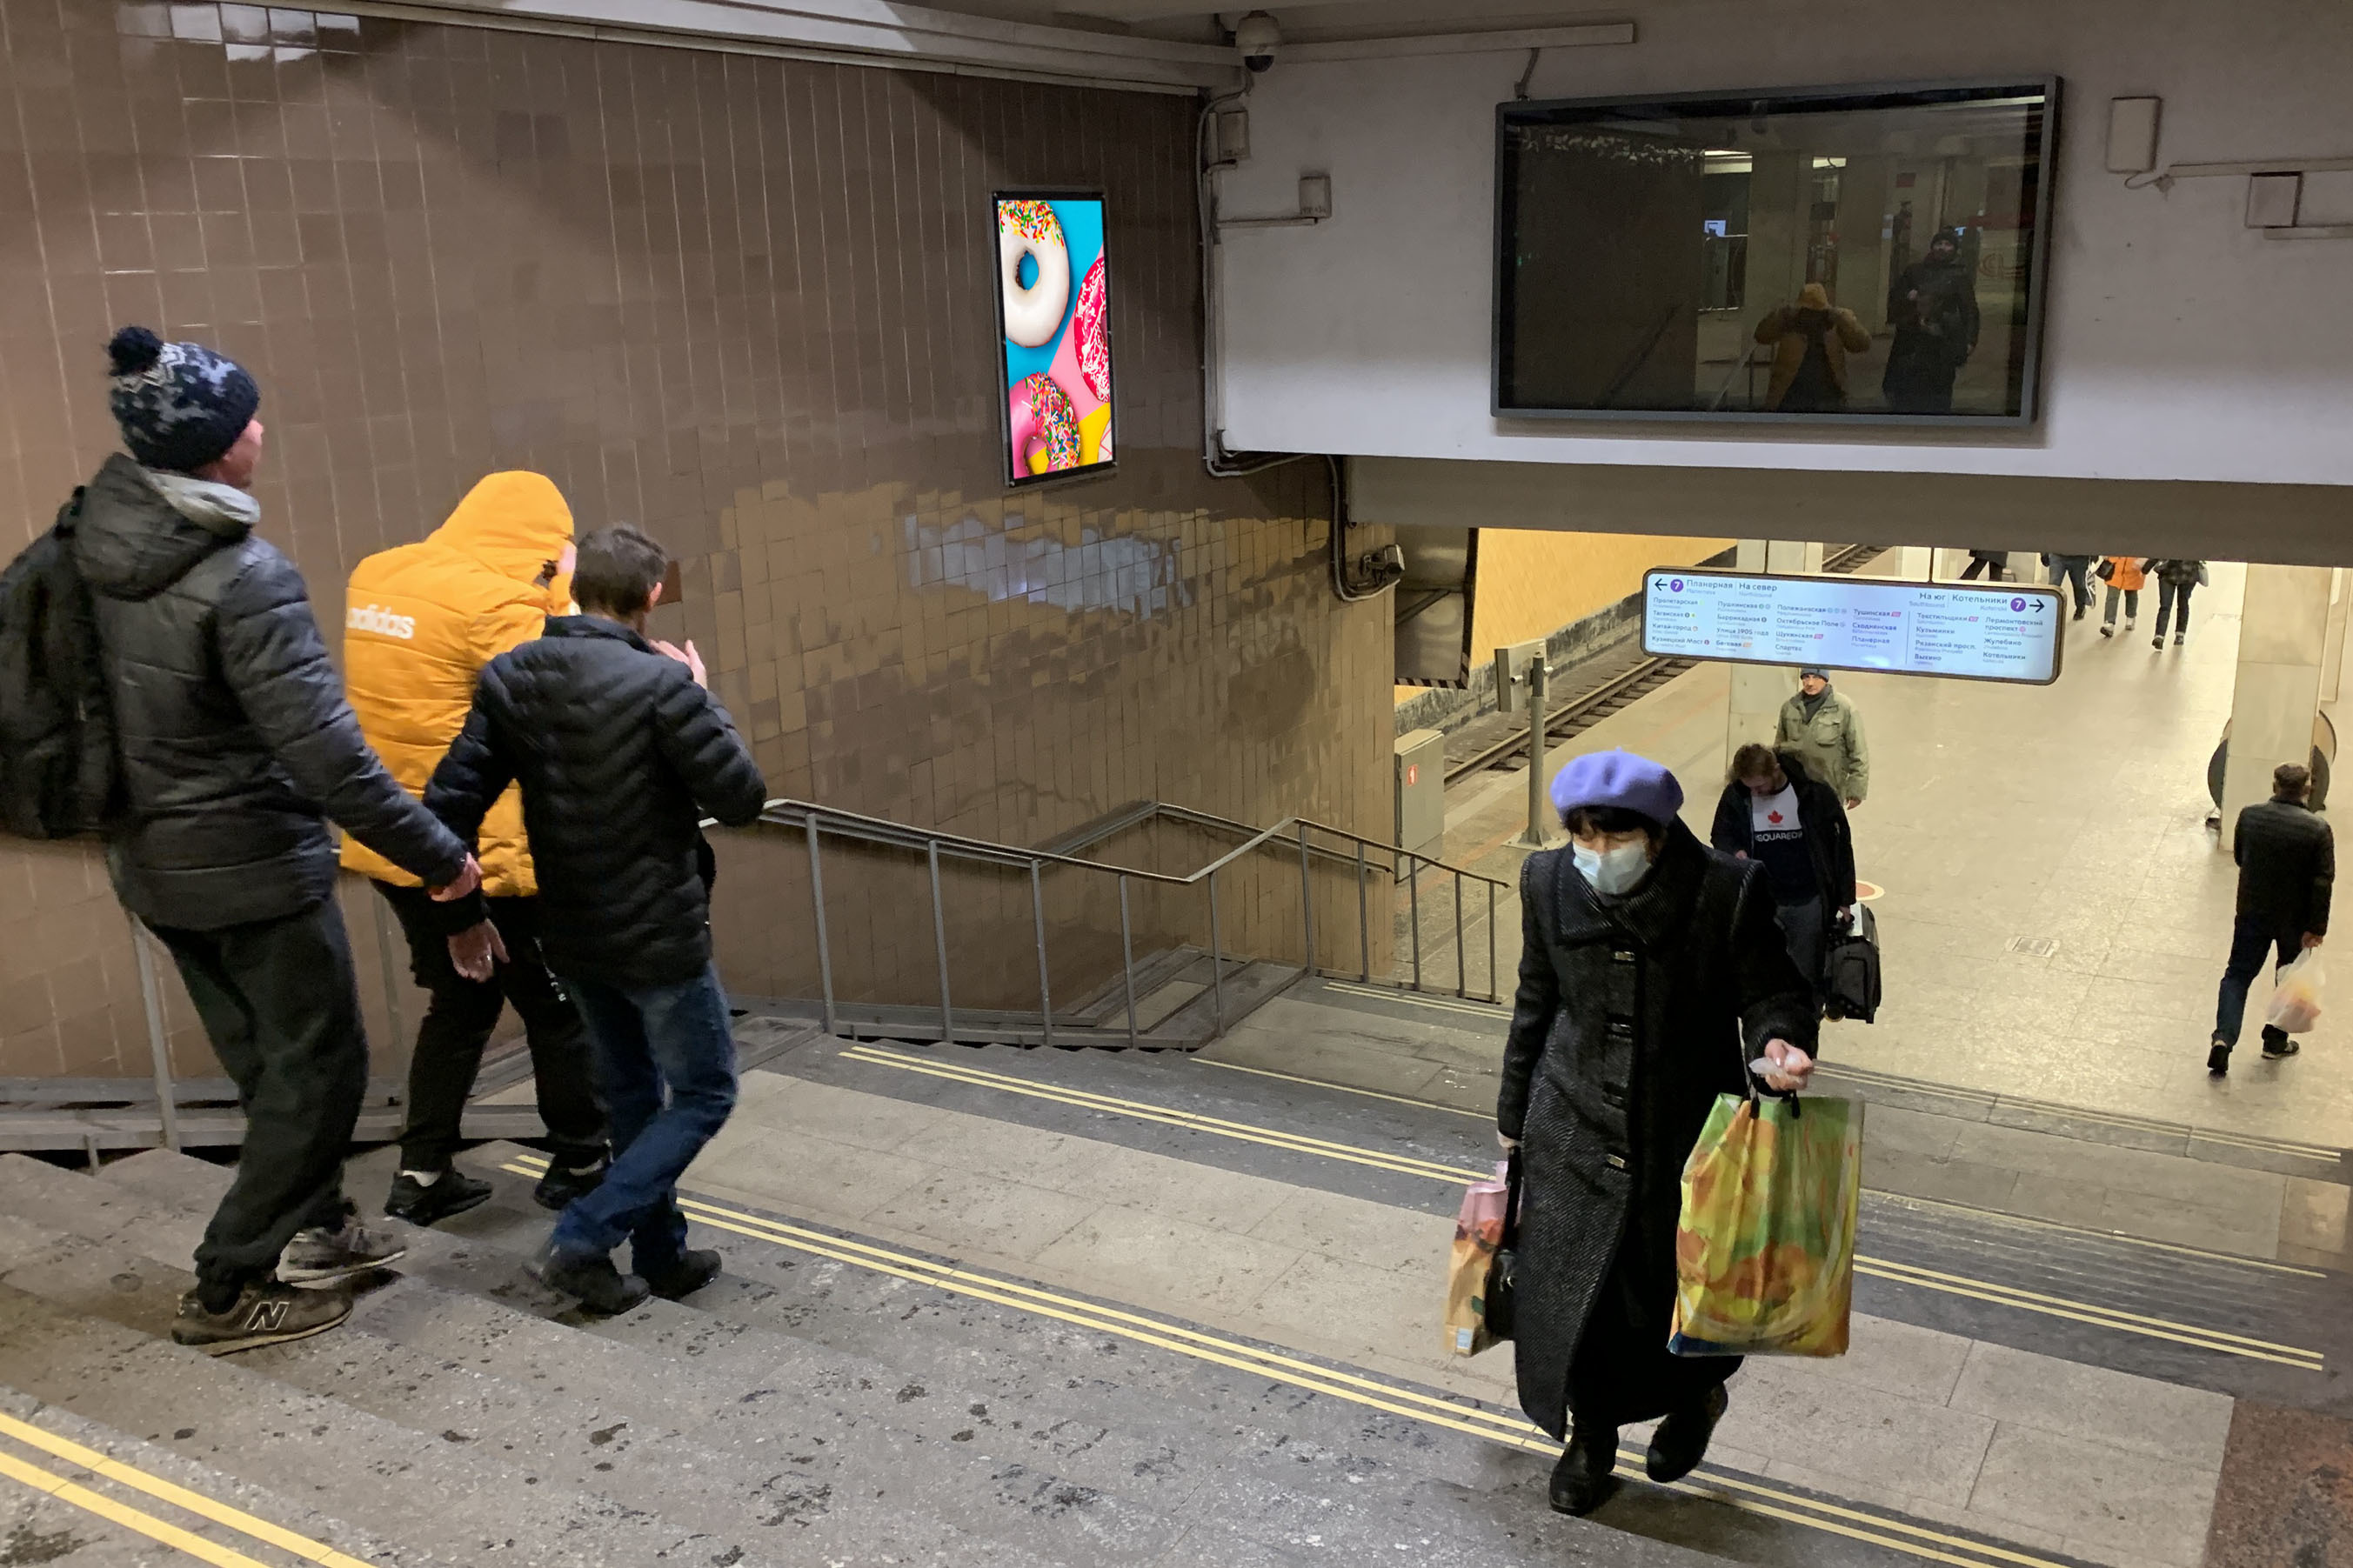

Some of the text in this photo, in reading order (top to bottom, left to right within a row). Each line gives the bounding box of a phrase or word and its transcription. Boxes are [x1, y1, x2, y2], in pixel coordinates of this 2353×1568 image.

[1686, 579, 1734, 590] Планерная
[1752, 584, 1778, 593] север
[1654, 597, 1698, 606] Пролетарская
[1952, 594, 2008, 604] Котельники
[1717, 600, 1758, 610] Пушкинская
[1654, 610, 1684, 618] Таганская
[1854, 609, 1890, 617] Тушинская
[1917, 612, 1969, 622] Текстильщики
[1717, 613, 1761, 623] Баррикадная
[1776, 617, 1820, 627] Октябрьское
[1985, 617, 2044, 626] Лермонтовский
[1653, 623, 1692, 632] Китай-город
[1716, 626, 1736, 635] Улица
[1852, 622, 1897, 631] Сходненская
[1915, 626, 1955, 636] Кузьминки
[1985, 624, 2018, 633] проспект
[1652, 635, 1686, 644] Кузнецкий
[1775, 631, 1814, 640] Щукинская
[1852, 636, 1890, 645] Планерная
[1915, 639, 1952, 649] Рязанский
[1953, 642, 1977, 651] просп.
[1983, 637, 2022, 648] Жулебино
[1775, 644, 1803, 652] Спартак
[1914, 653, 1942, 662] Выхино
[1982, 651, 2027, 661] Котельники
[244, 1300, 291, 1331] N
